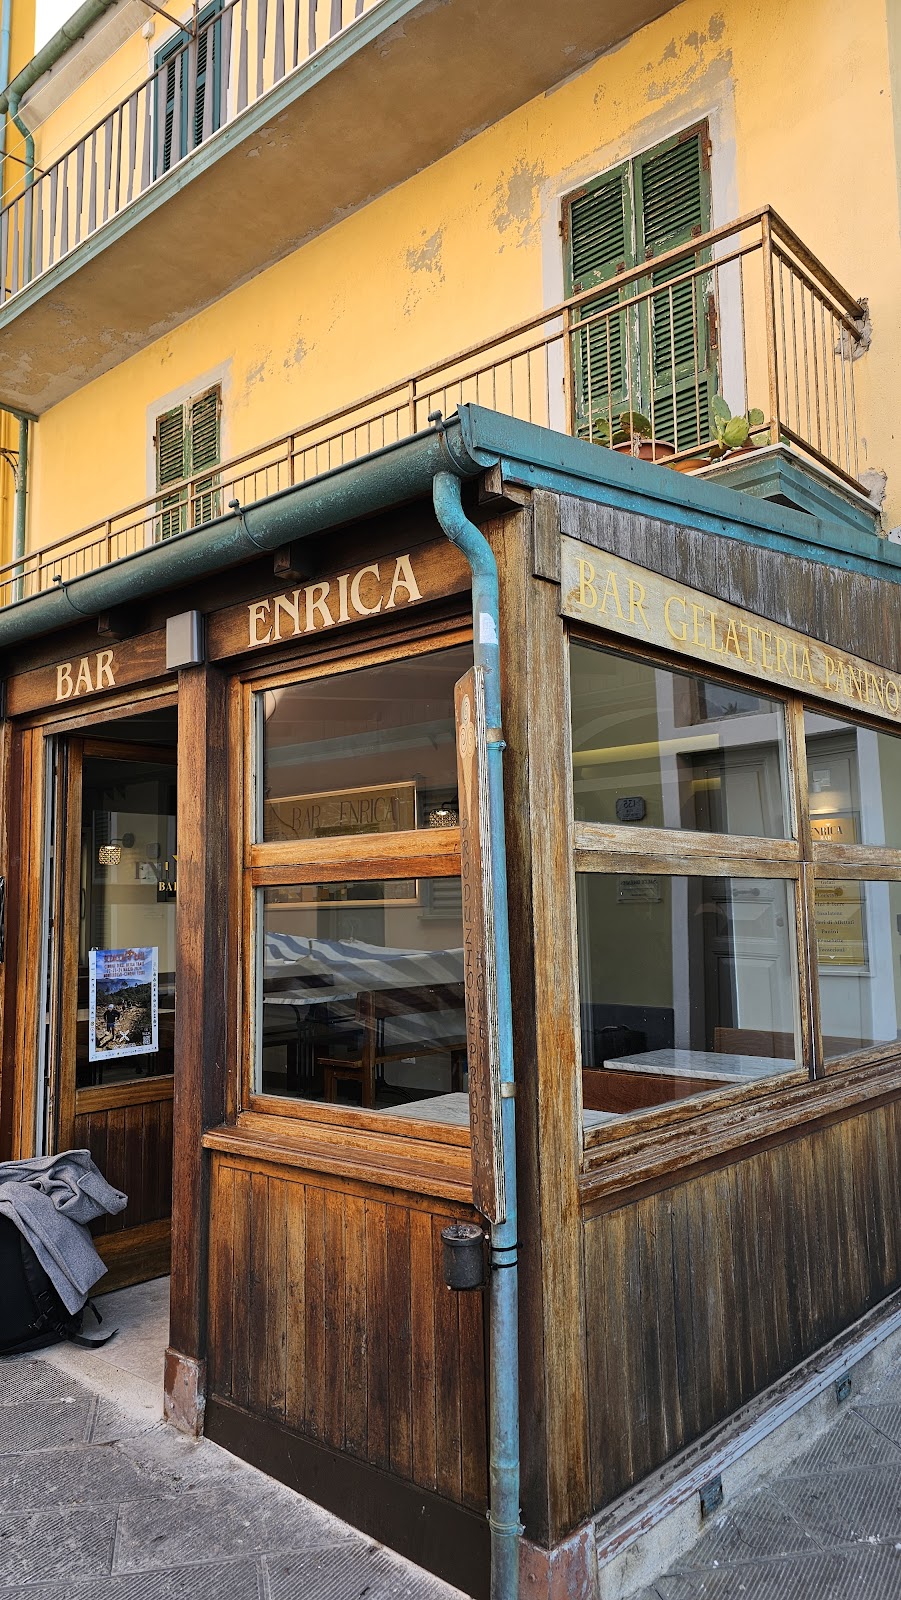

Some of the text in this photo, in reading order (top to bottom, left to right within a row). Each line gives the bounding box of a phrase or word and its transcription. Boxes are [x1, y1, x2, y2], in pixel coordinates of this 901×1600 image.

[56, 553, 423, 701] BAR ENRICA
[575, 558, 901, 713] BAR GELATERIA PANINO
[292, 796, 397, 830] BAR ENRICA
[461, 818, 475, 1036] PRODUZIONE
